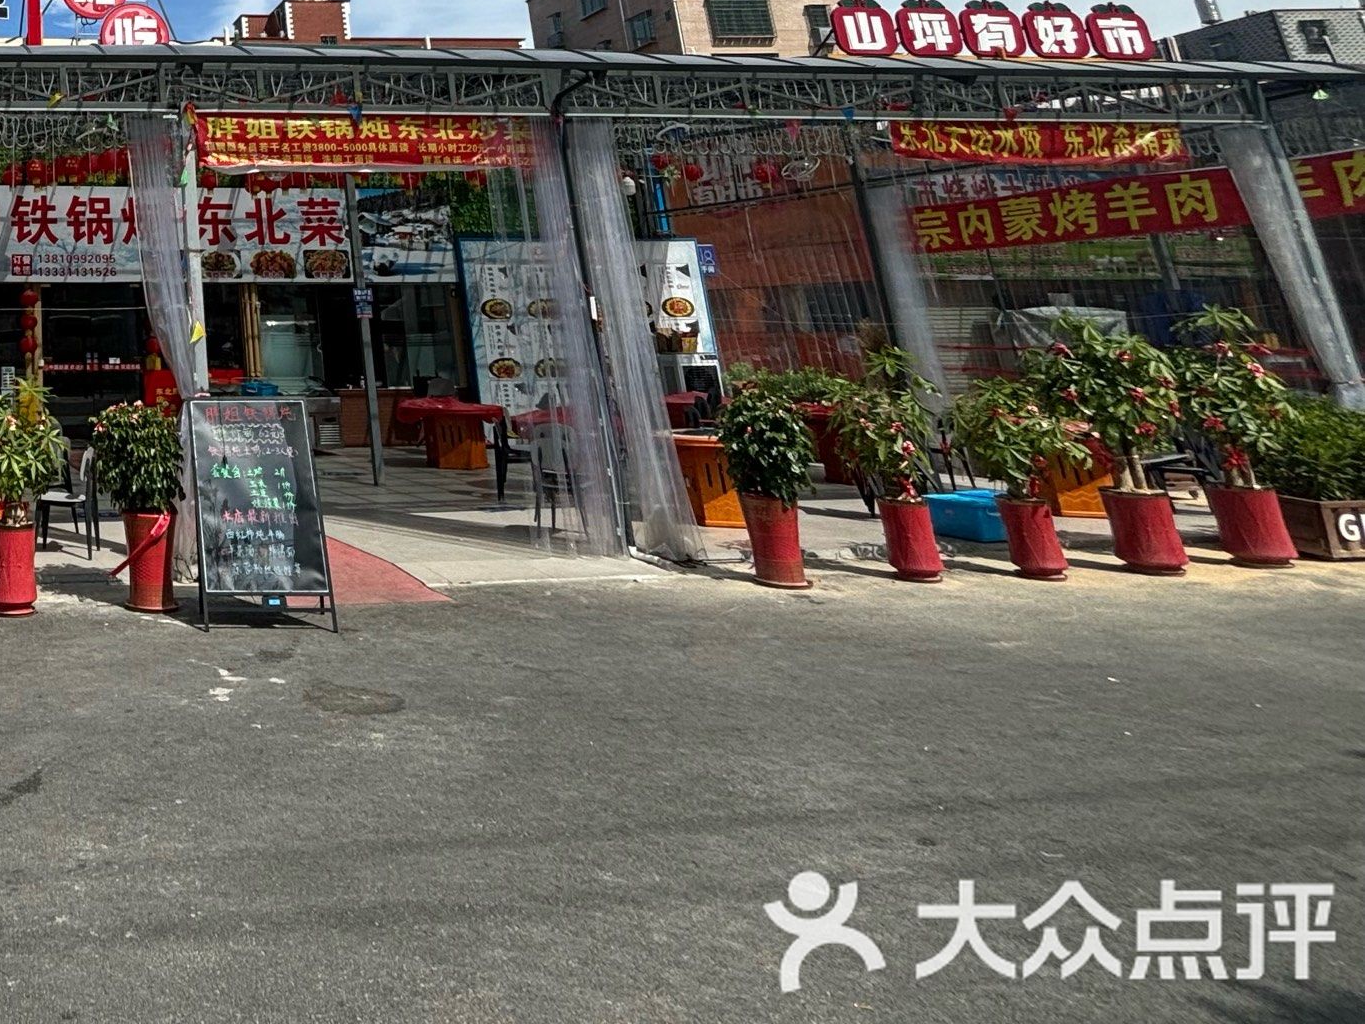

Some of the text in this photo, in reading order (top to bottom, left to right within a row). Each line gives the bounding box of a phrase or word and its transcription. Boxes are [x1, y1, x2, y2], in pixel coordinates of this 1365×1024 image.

[843, 11, 1146, 55] 山坪有好市
[37, 254, 117, 264] 13810992095
[38, 266, 118, 277] 13331131526
[1338, 513, 1365, 542] G
